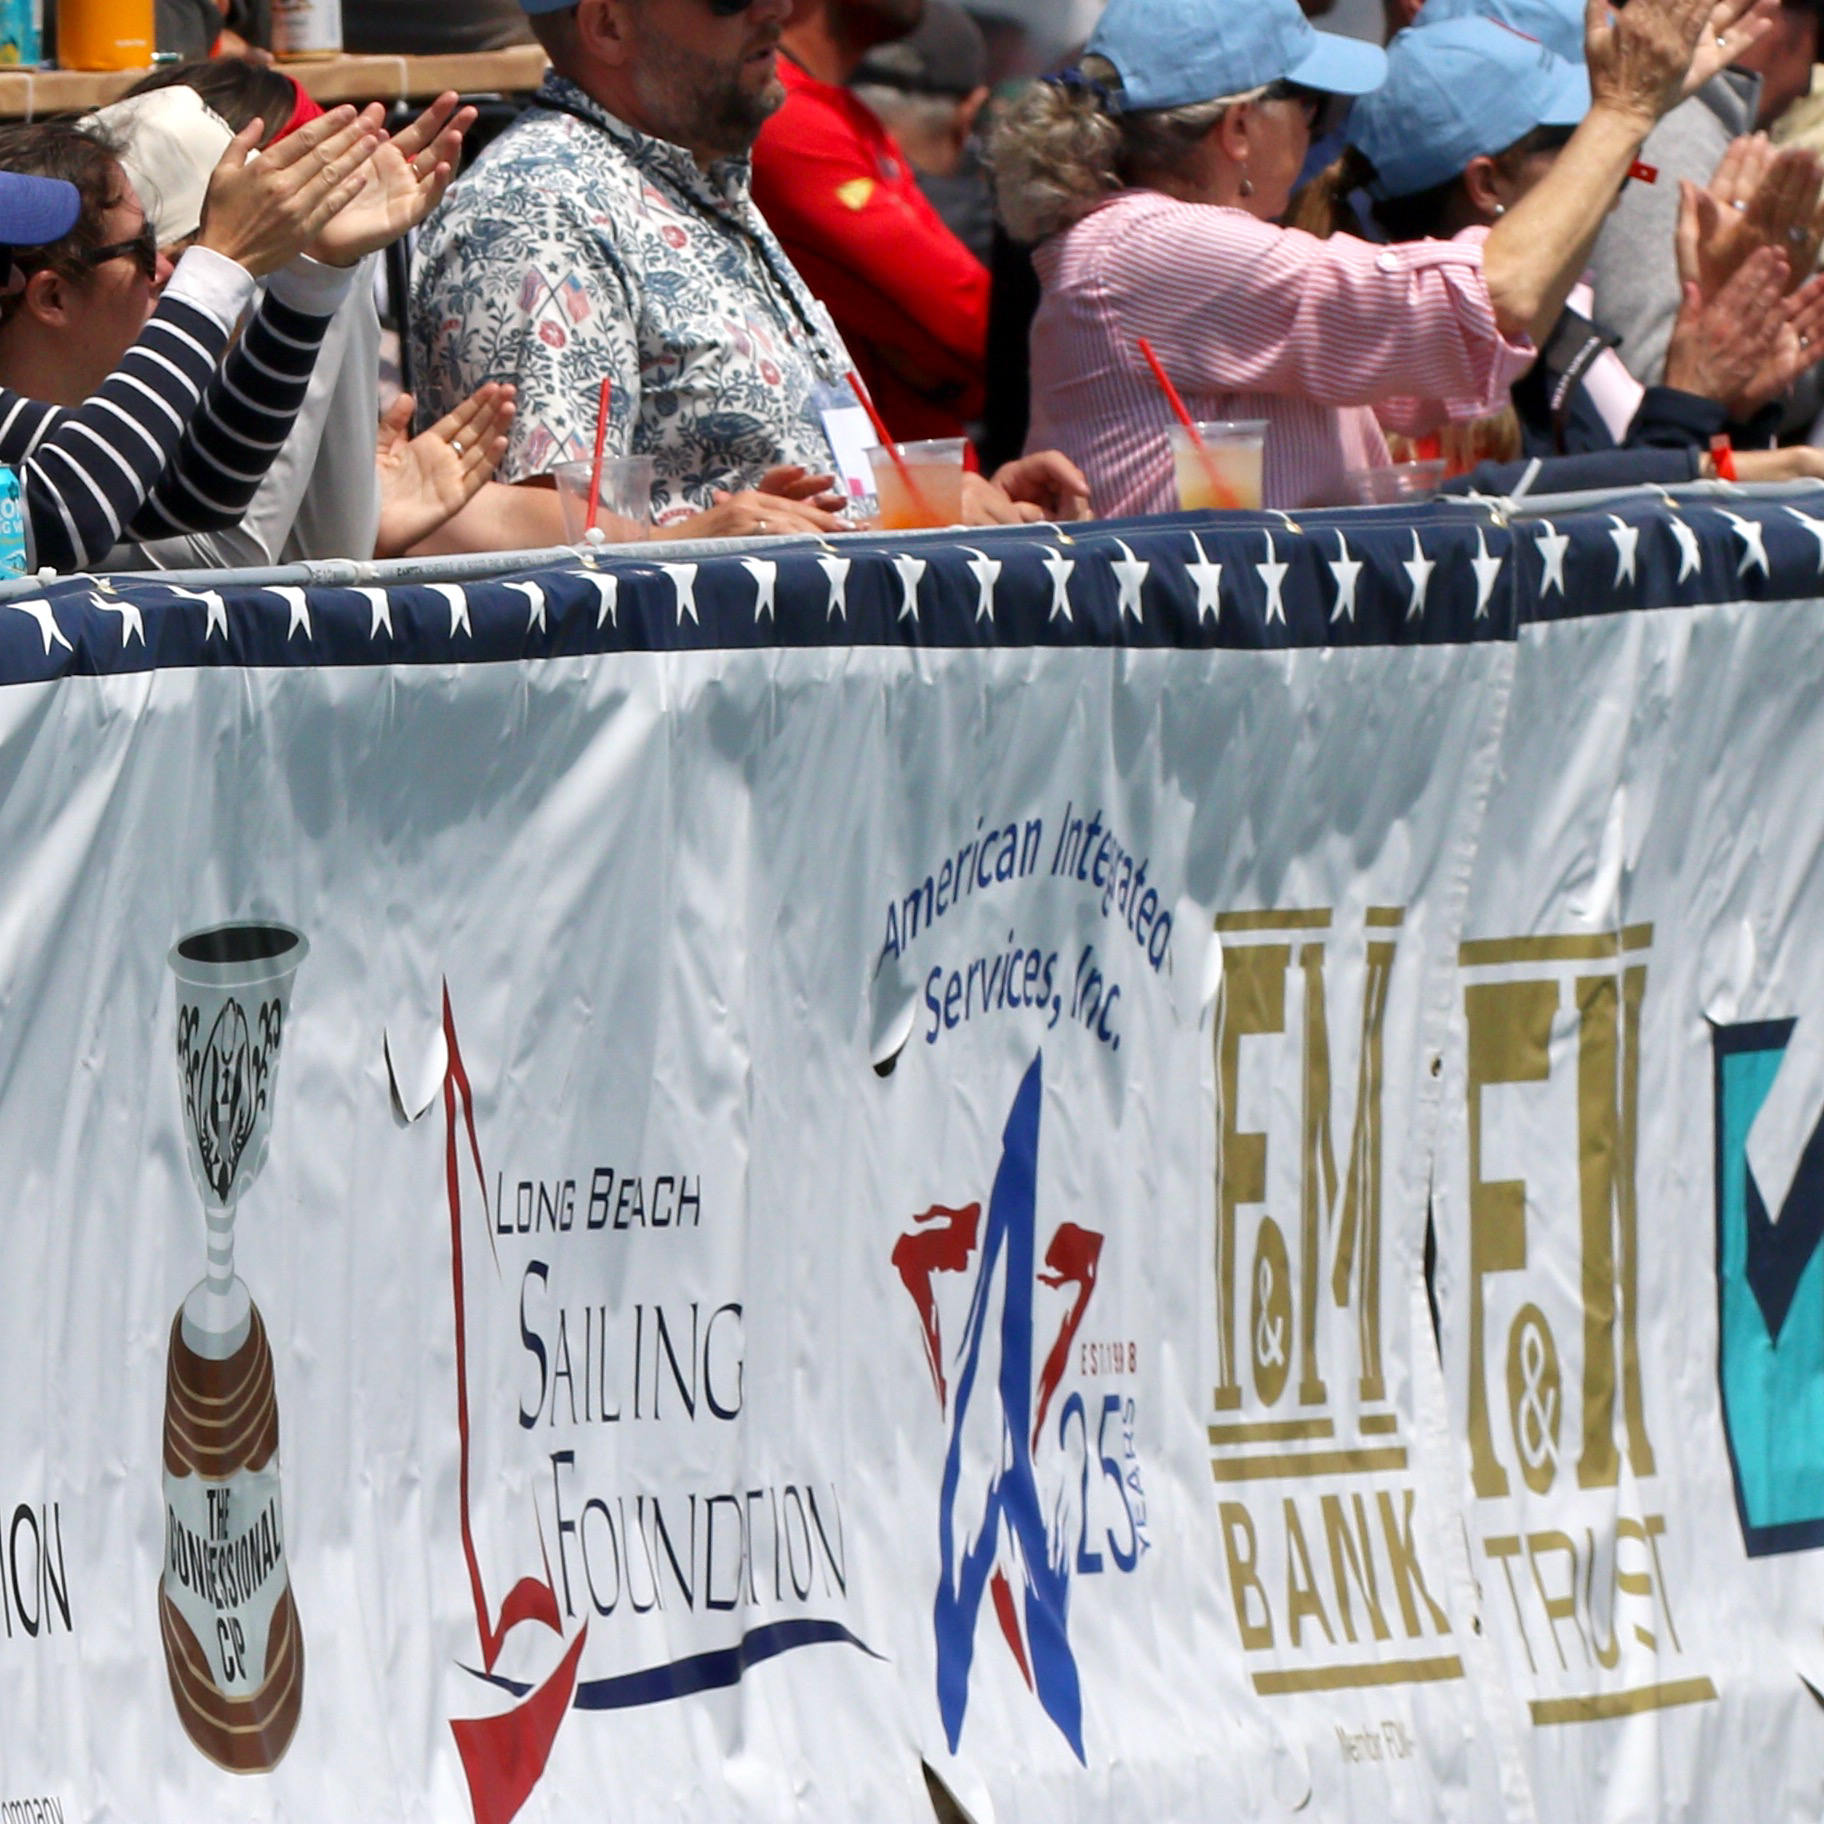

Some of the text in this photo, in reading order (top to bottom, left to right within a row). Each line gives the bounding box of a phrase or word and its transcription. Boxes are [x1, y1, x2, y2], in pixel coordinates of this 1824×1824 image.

[874, 815, 1043, 982] American
[926, 928, 1121, 1052] Services, Inc.
[549, 1450, 847, 1618] FOUNDTION
[1059, 1390, 1138, 1574] 25
[1219, 1488, 1454, 1652] BANK
